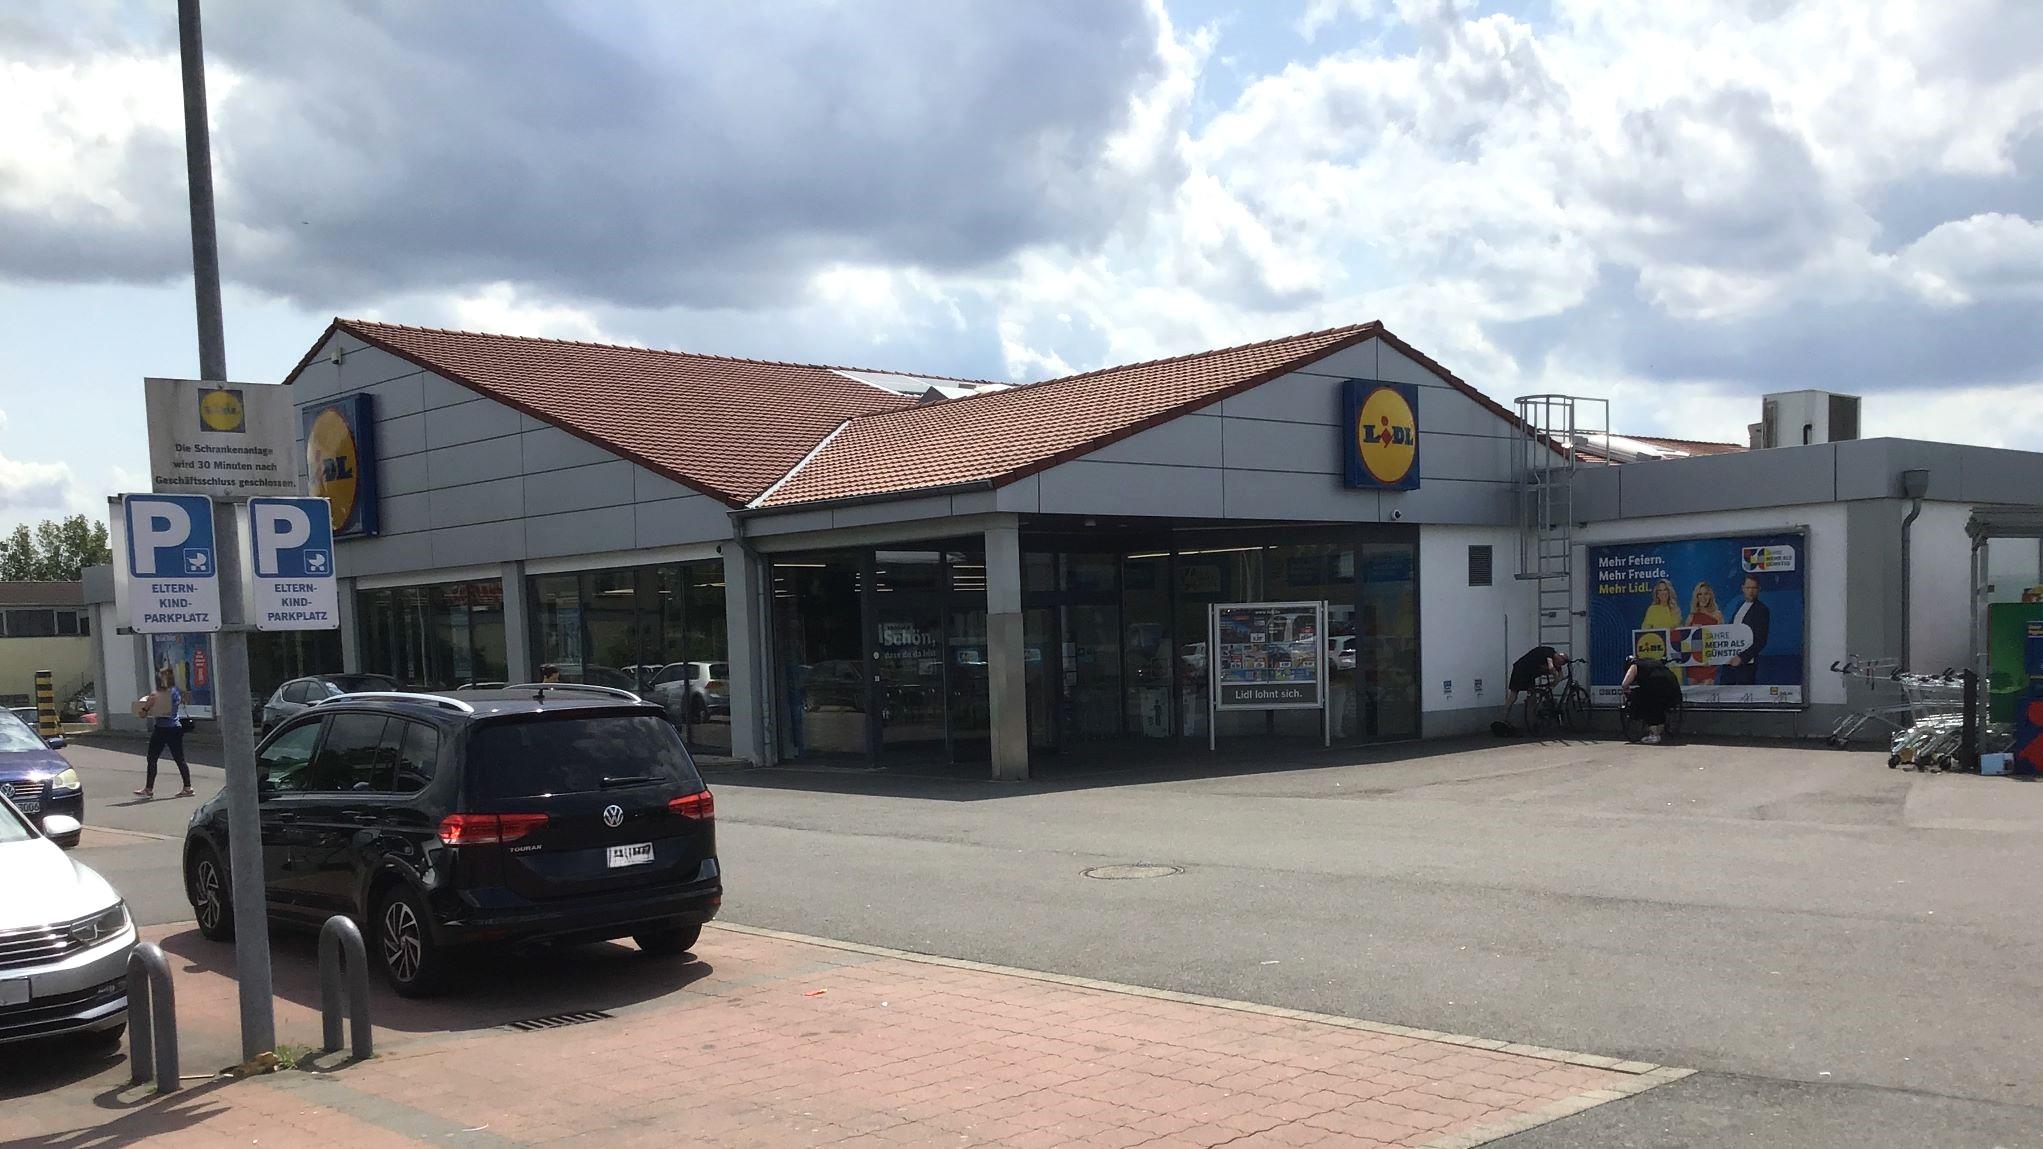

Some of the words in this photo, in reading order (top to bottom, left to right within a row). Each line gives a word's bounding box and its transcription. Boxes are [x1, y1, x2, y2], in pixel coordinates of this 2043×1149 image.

[1363, 416, 1414, 448] LIDL
[175, 444, 192, 453] Die
[194, 444, 273, 456] Schrankenanlage
[174, 460, 195, 469] wird
[198, 461, 210, 470] 30
[214, 462, 253, 471] Minuten
[255, 462, 277, 472] nach
[155, 476, 236, 487] Geschäftsschluss
[239, 477, 297, 489] geschlossen.
[130, 501, 191, 574] P
[255, 504, 311, 575] P
[1599, 557, 1627, 568] Mehr
[1628, 554, 1665, 566] Feiern.
[1599, 570, 1627, 581] Mehr
[1628, 568, 1670, 580] Freude.
[152, 584, 198, 594] ELTERN-
[274, 583, 318, 593] ELTERN-
[1599, 584, 1627, 595] Mehr
[1628, 581, 1652, 593] Lidl.
[159, 598, 192, 608] KIND-
[281, 598, 312, 607] KIND-
[144, 612, 209, 623] PARKPLATZ
[267, 611, 328, 622] PARKPLATZ
[1705, 640, 1729, 649] MEHR
[1730, 639, 1746, 648] ALS
[1705, 647, 1743, 658] GÜNSTIG
[1235, 690, 1252, 699] Lidl
[1255, 689, 1279, 699] lohnt
[1281, 689, 1303, 699] sich.
[510, 844, 542, 853] TOURAN
